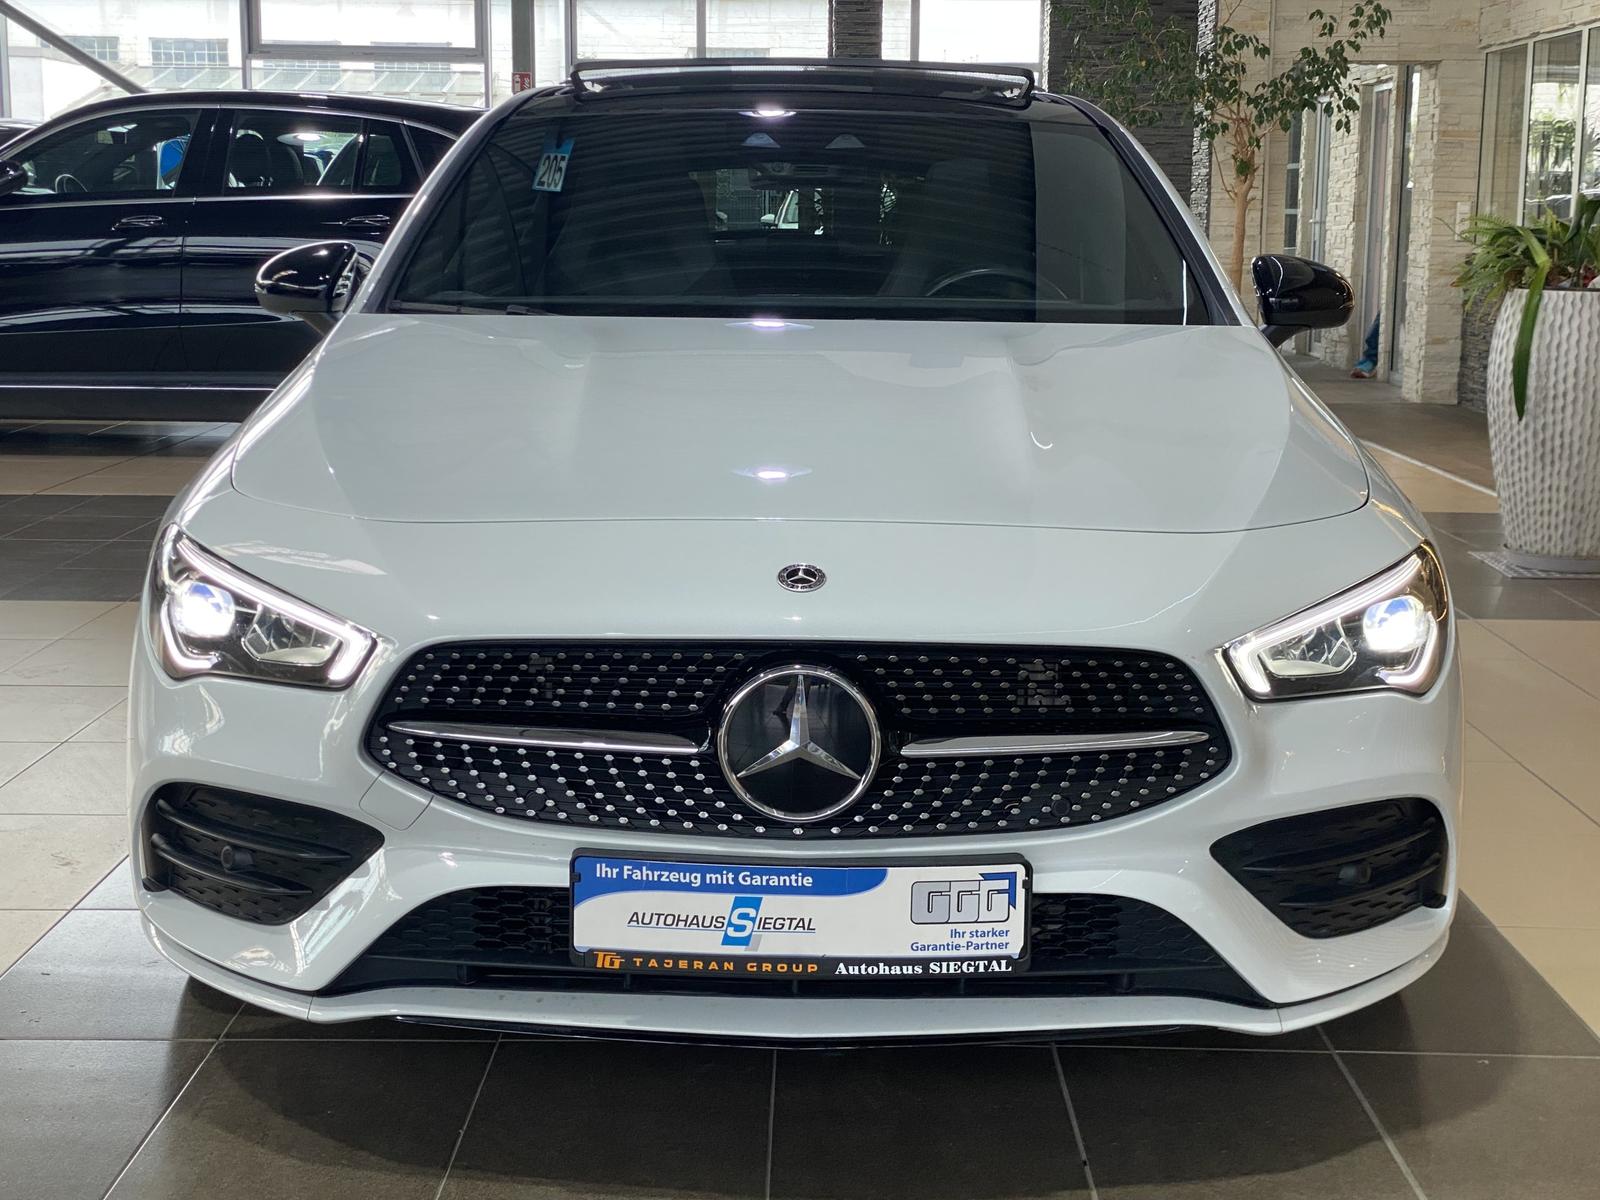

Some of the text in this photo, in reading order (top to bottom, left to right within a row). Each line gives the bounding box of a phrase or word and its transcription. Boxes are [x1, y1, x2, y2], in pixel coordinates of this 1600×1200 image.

[536, 154, 567, 188] 205
[596, 863, 813, 887] Ihr Fahrzeug mit Garantie
[627, 911, 726, 930] AUTOHAUS
[950, 928, 1010, 939] Ihr starker
[910, 940, 1010, 952] Garantie-Partner
[632, 957, 735, 971] TAJERAN
[746, 962, 819, 974] GROUP
[834, 959, 1012, 975] Autohaus SIEGTAL
